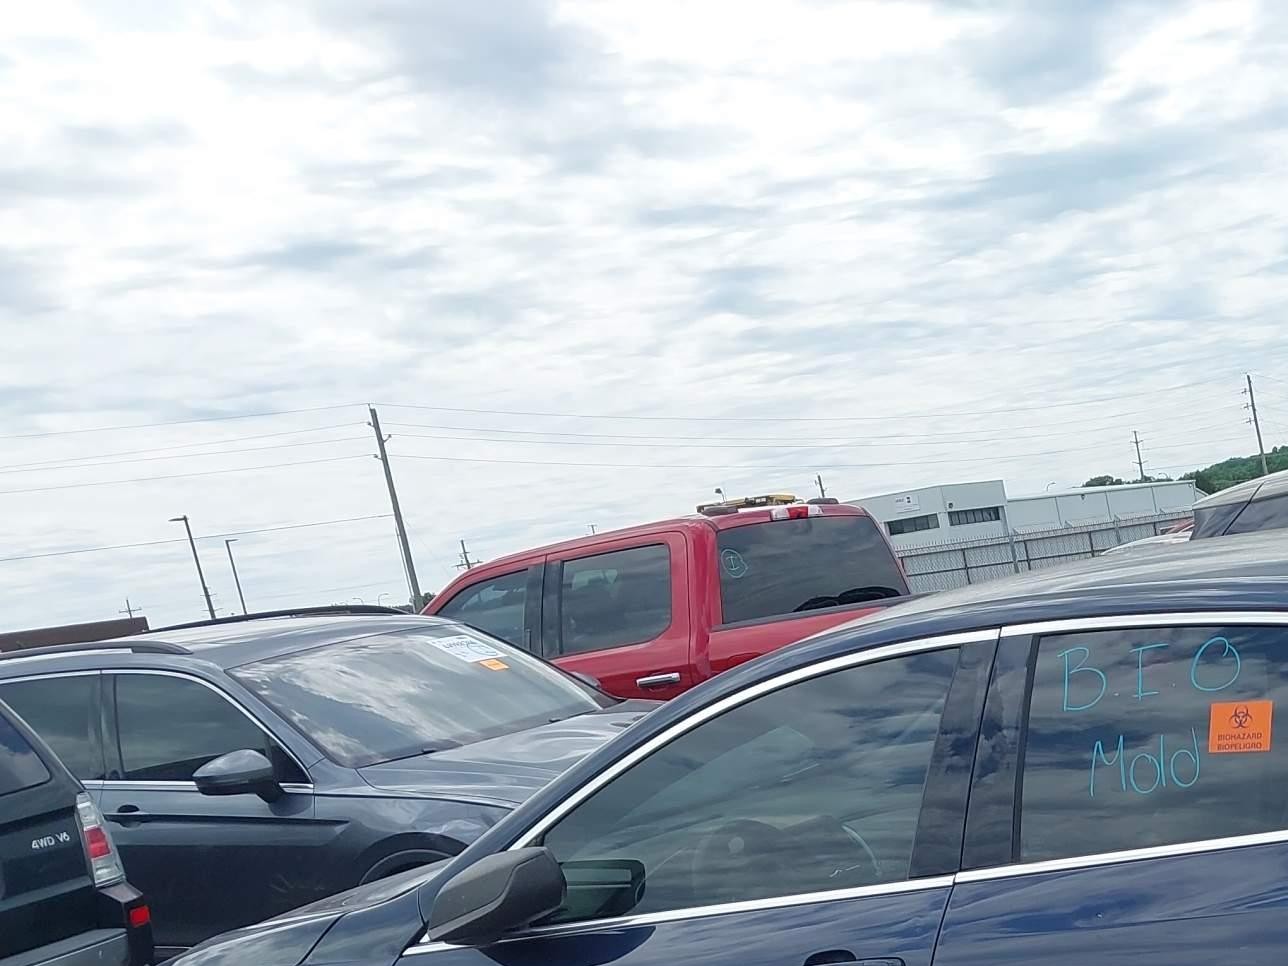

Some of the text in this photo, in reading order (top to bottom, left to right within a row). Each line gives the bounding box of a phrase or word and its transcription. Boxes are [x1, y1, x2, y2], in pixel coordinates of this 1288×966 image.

[1217, 732, 1263, 742] BIOHAZARD
[1217, 742, 1262, 751] BIOPELIGRO
[1090, 727, 1200, 797] Mold
[31, 831, 70, 849] 4WD V6
